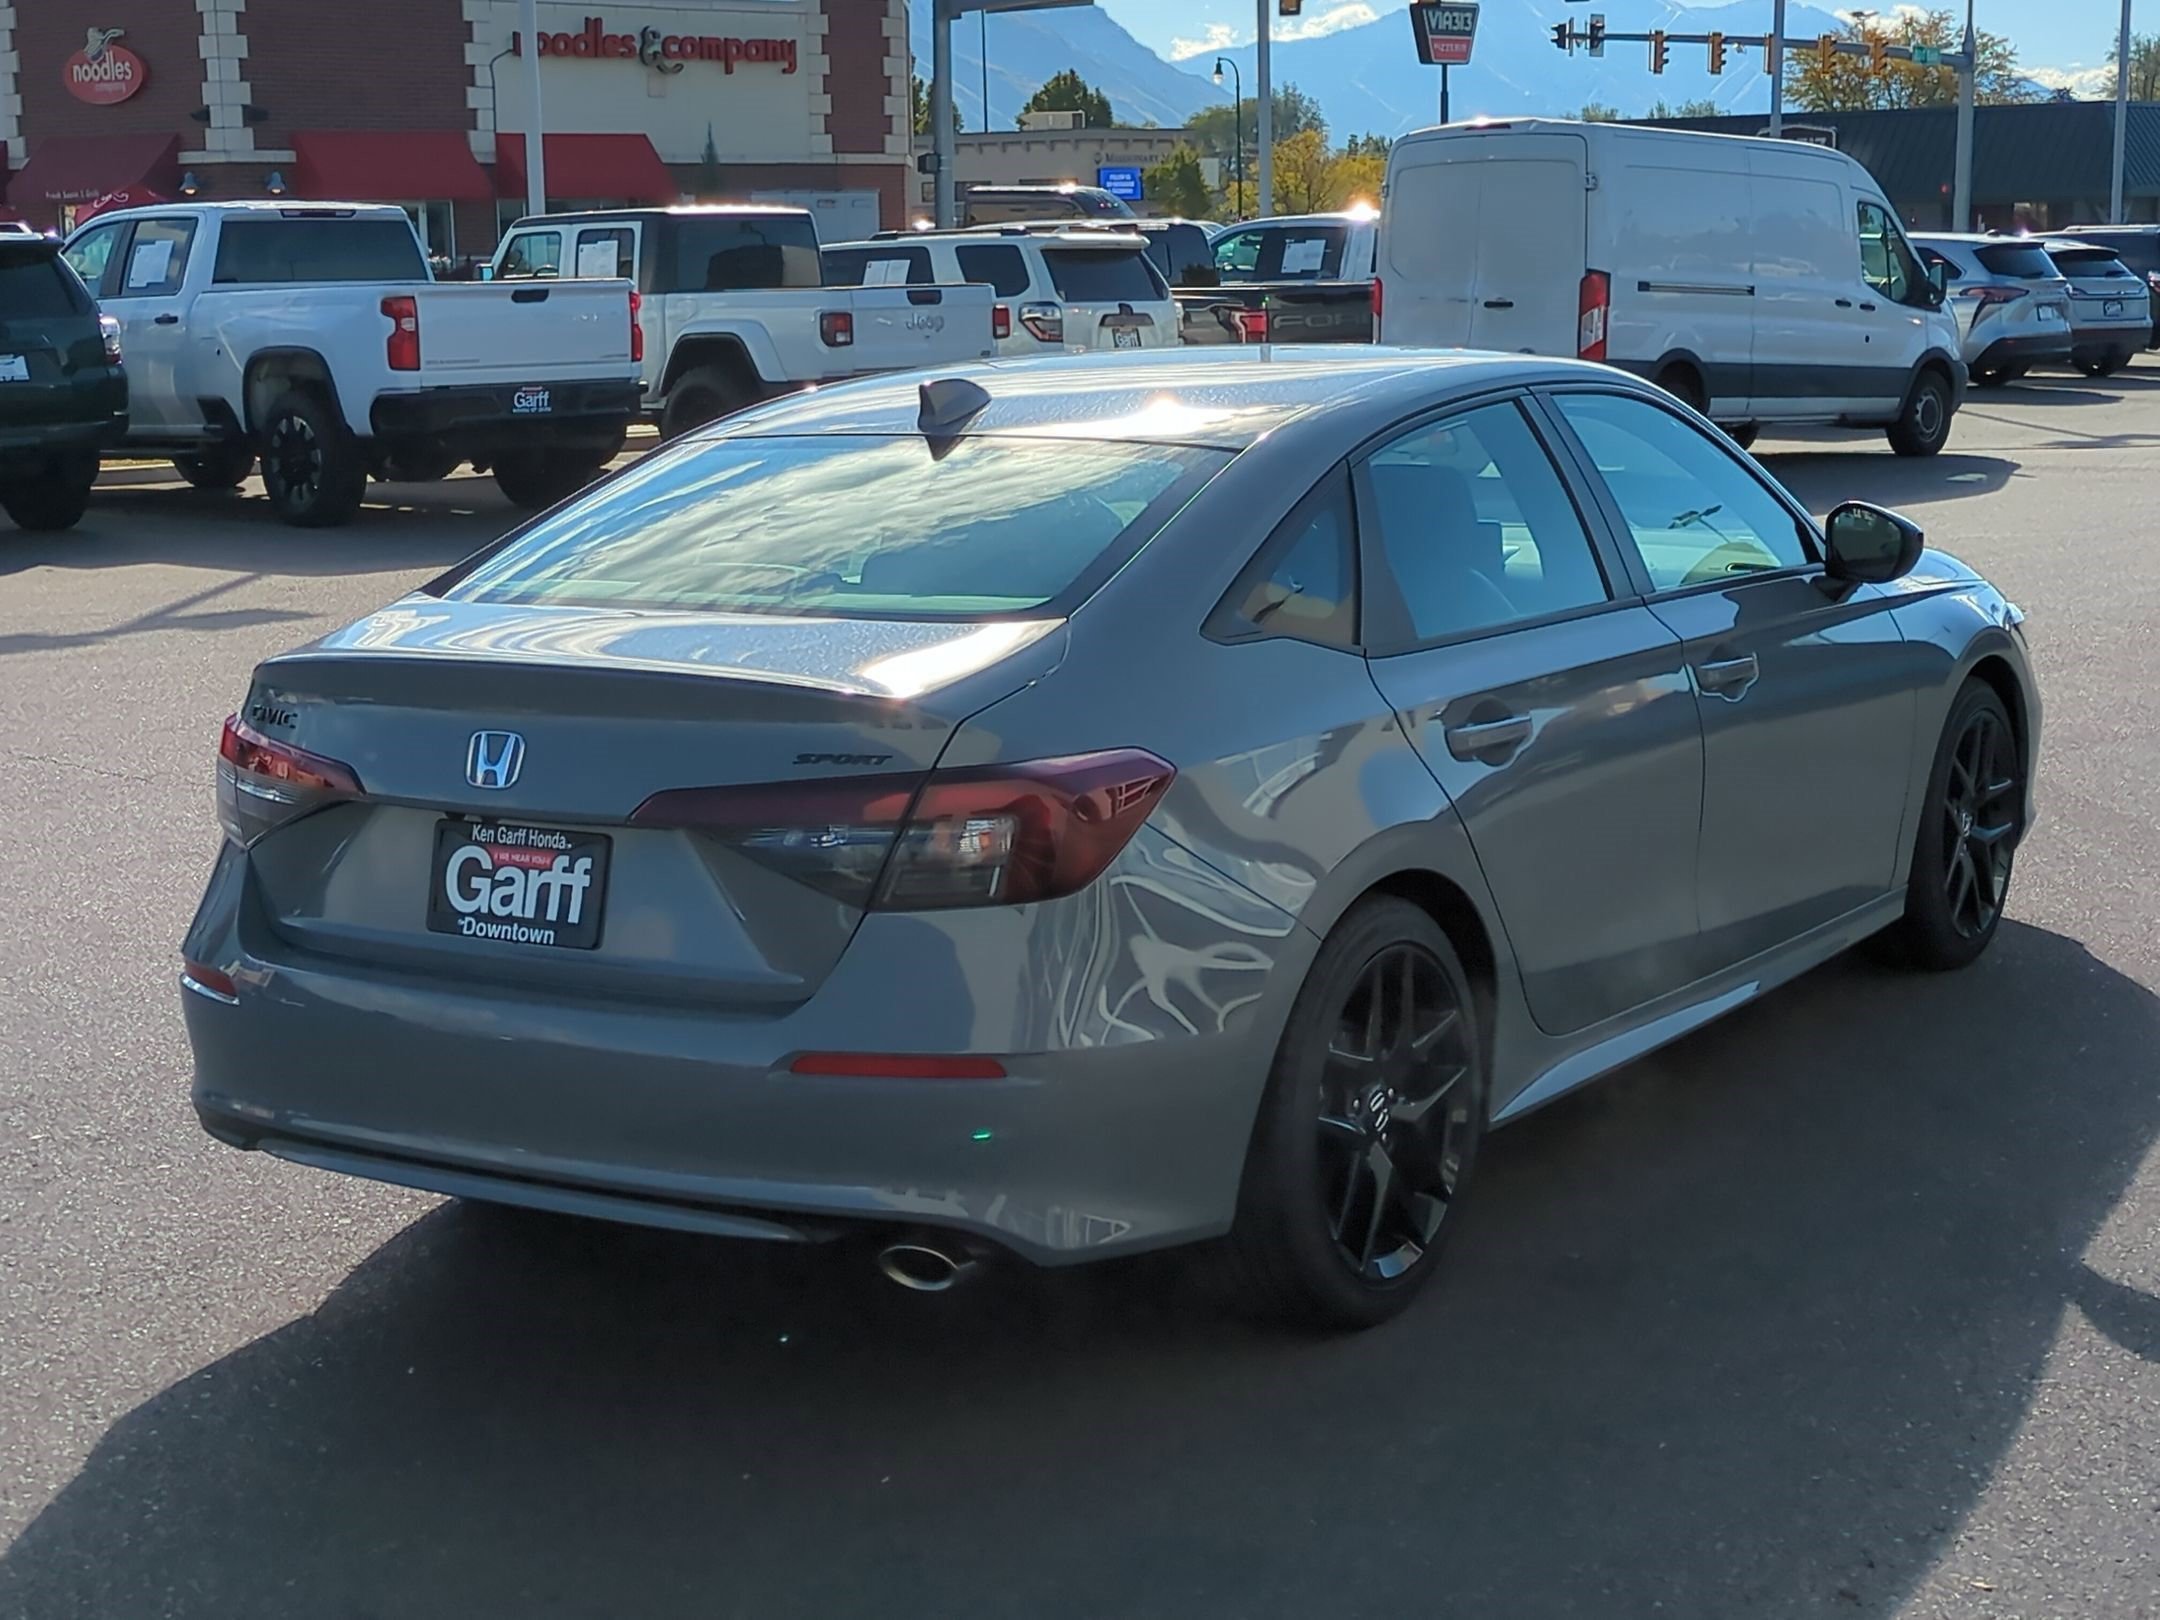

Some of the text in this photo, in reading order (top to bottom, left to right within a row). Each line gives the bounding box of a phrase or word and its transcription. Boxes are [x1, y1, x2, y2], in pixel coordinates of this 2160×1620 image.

[1428, 10, 1473, 31] VIA313
[72, 50, 132, 83] noodles
[661, 36, 798, 75] company
[905, 313, 945, 333] Jeep
[513, 391, 550, 408] Garff
[252, 705, 298, 729] CIVIC
[792, 753, 893, 765] SPORT
[471, 824, 566, 850] Ken Garff Honda
[445, 845, 592, 924] Garff
[462, 917, 555, 945] Downtown
